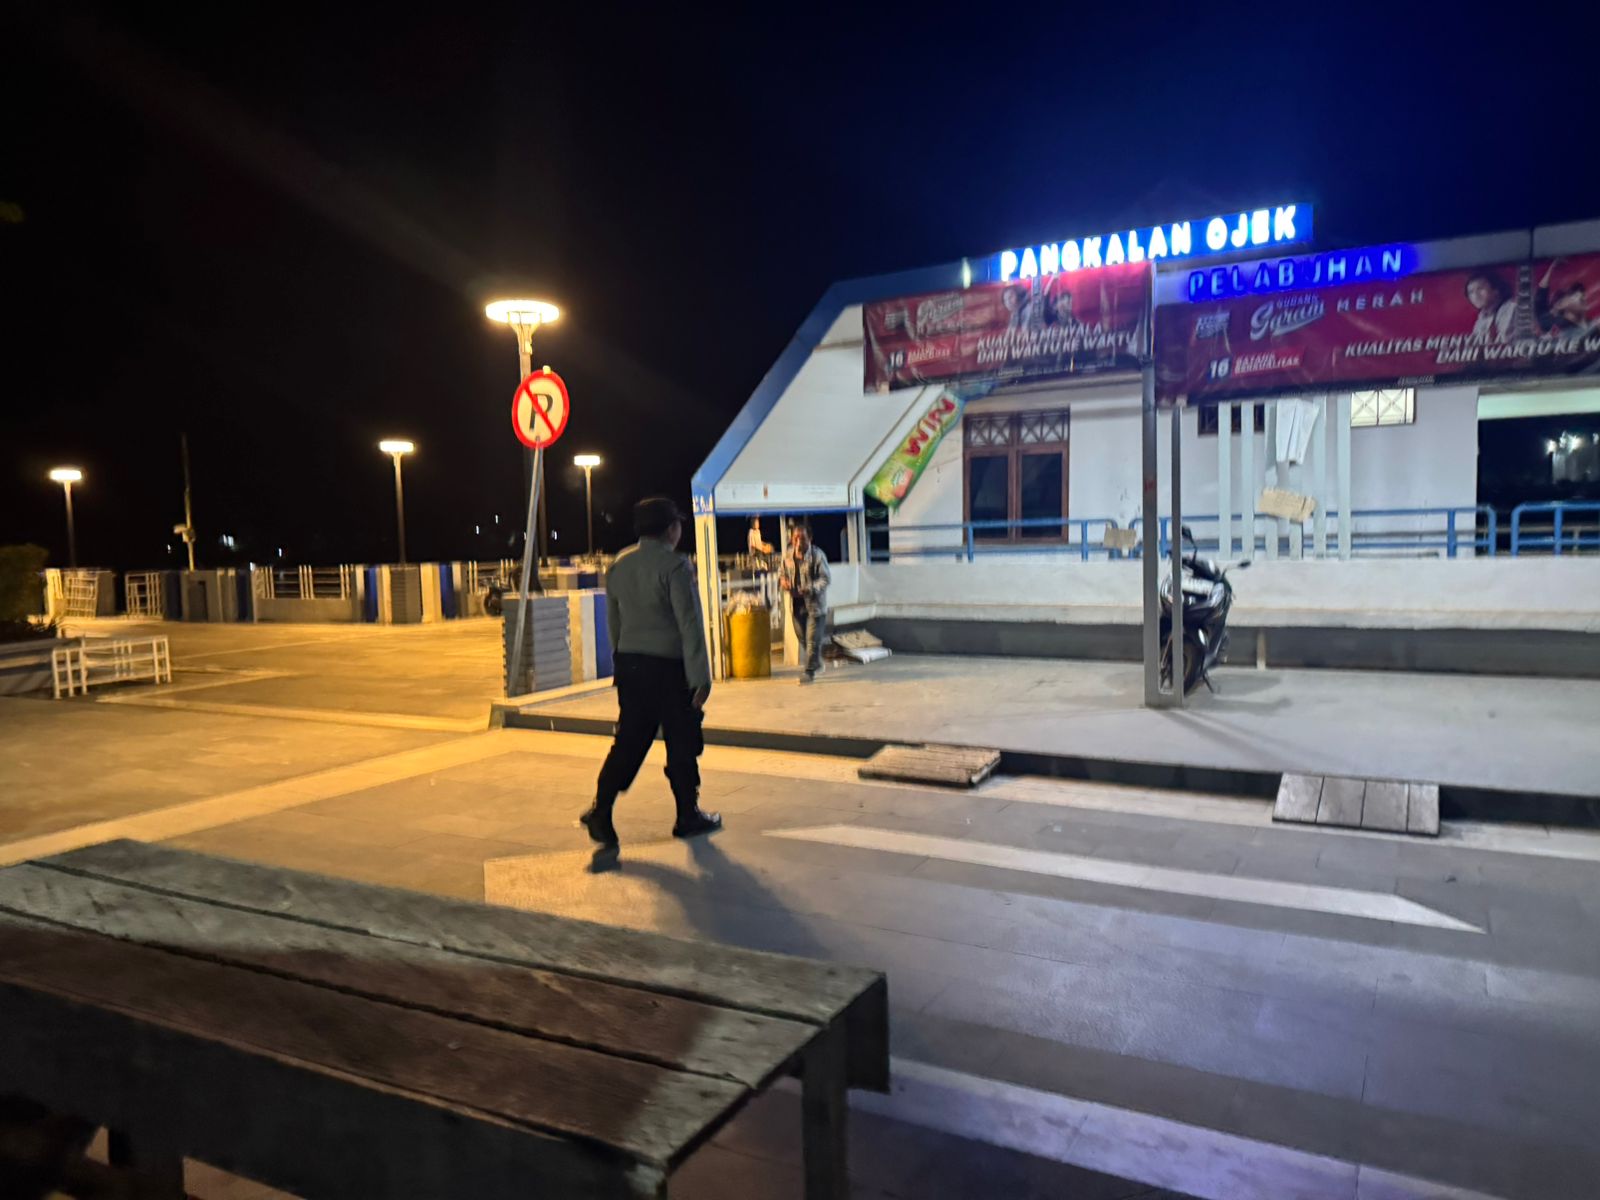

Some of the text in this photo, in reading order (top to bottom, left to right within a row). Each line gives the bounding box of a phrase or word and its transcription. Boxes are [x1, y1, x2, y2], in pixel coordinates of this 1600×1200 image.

[1000, 204, 1297, 282] PANGKALAN OJEK
[1336, 288, 1425, 313] MERAH
[1344, 333, 1507, 358] KUALITAS MENYALA
[1436, 346, 1478, 364] DARI
[1481, 341, 1552, 360] WAKTU
[1553, 338, 1580, 355] KE
[1209, 357, 1230, 379] 16
